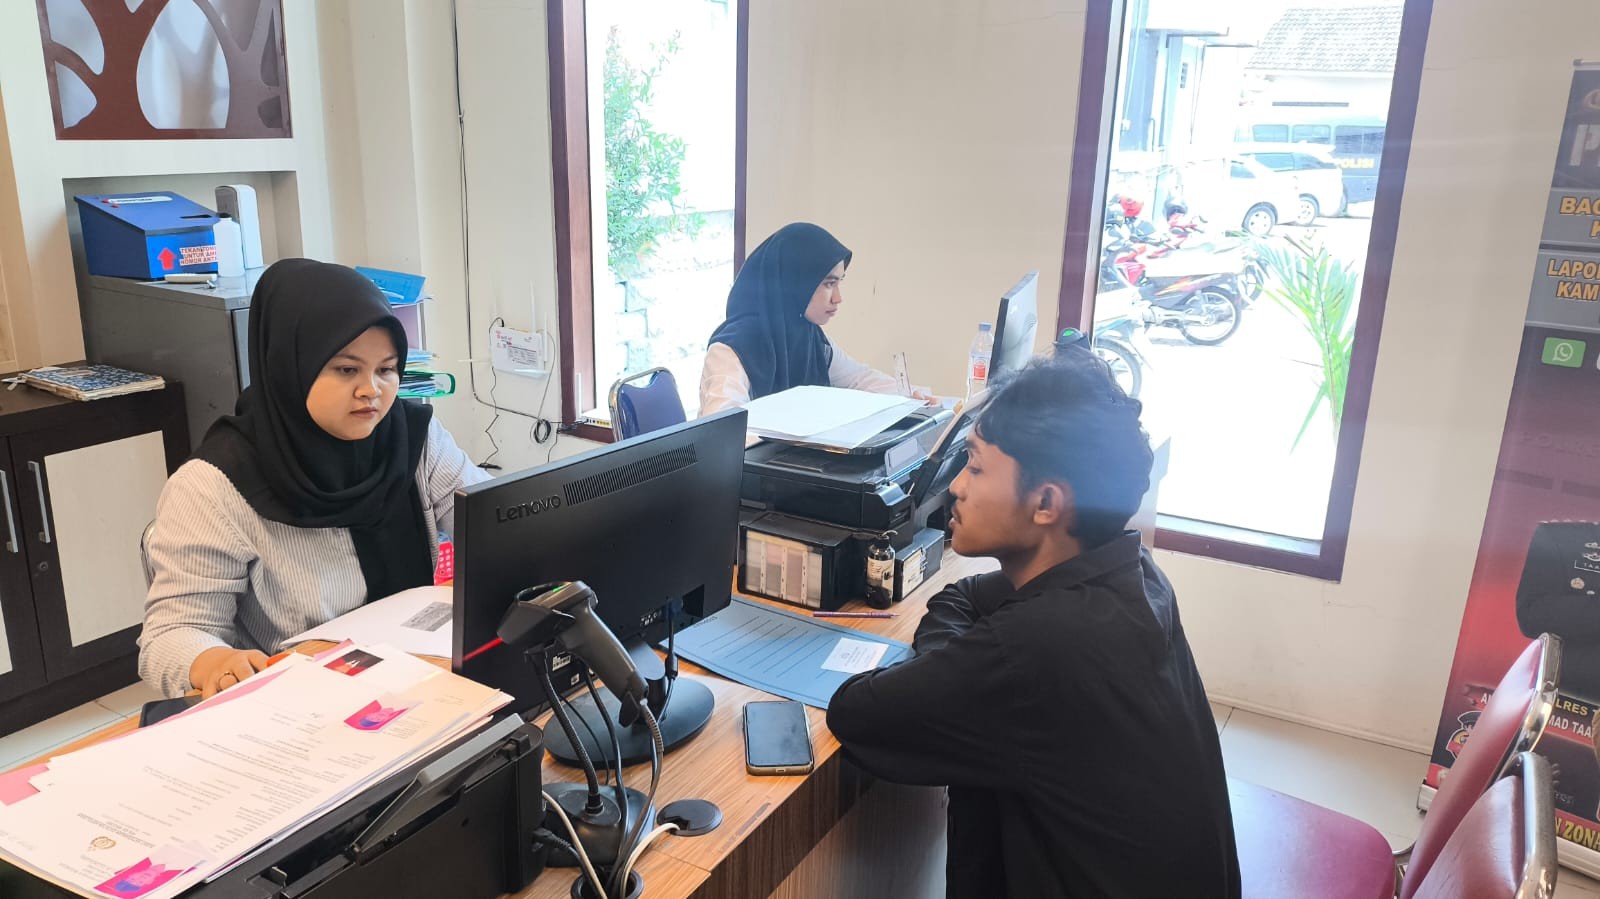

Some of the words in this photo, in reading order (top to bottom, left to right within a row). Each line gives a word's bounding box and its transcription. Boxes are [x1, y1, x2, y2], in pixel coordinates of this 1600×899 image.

[1569, 124, 1600, 166] P
[1547, 259, 1600, 280] LAPO
[496, 495, 562, 524] Lenovo
